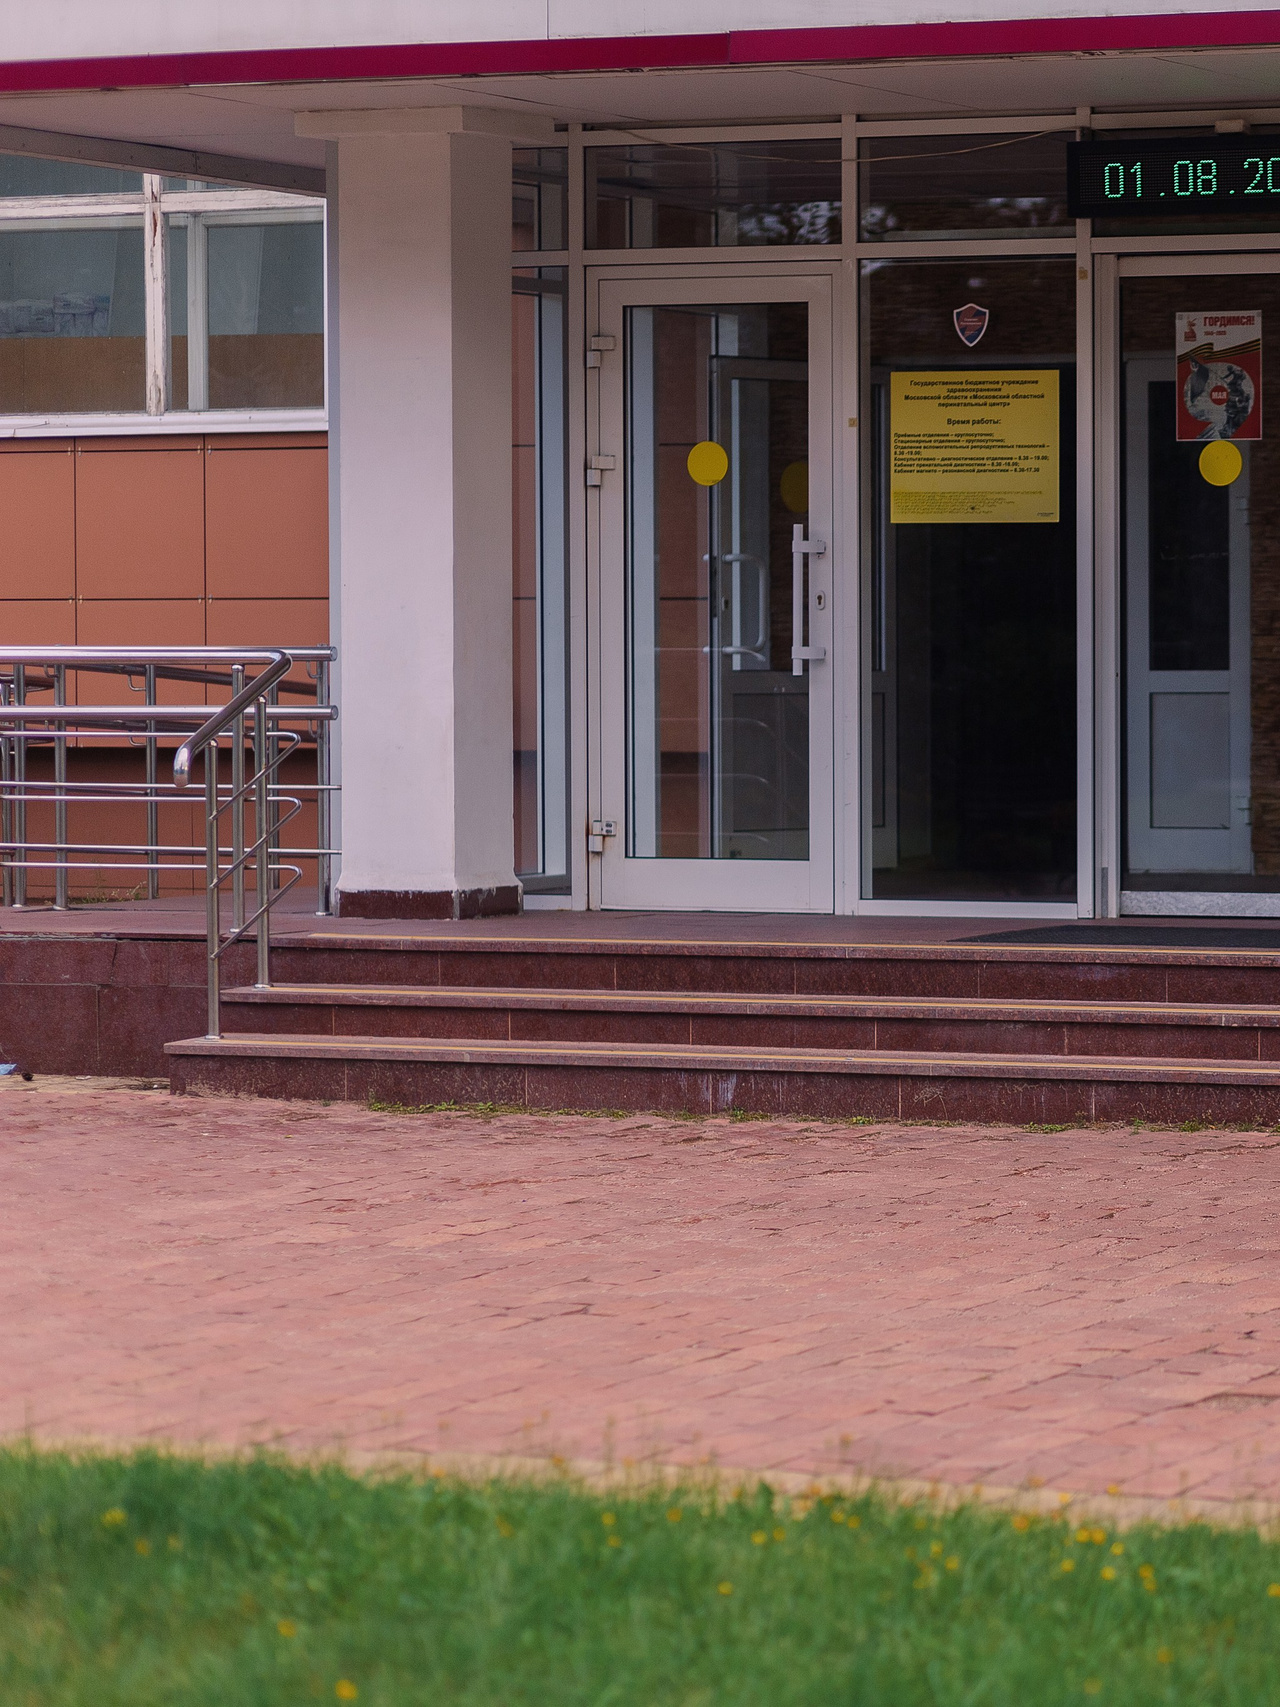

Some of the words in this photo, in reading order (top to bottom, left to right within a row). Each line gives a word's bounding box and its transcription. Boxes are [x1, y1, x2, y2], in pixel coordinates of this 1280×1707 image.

[1203, 315, 1255, 327] ГОРДИМСЯ!
[965, 379, 1000, 387] бюджетное
[1001, 379, 1039, 387] учреждение
[904, 393, 941, 401] Московской
[1011, 392, 1045, 400] областной
[1211, 391, 1227, 400] МАЯ
[947, 418, 970, 426] Время
[971, 417, 1002, 426] работы:
